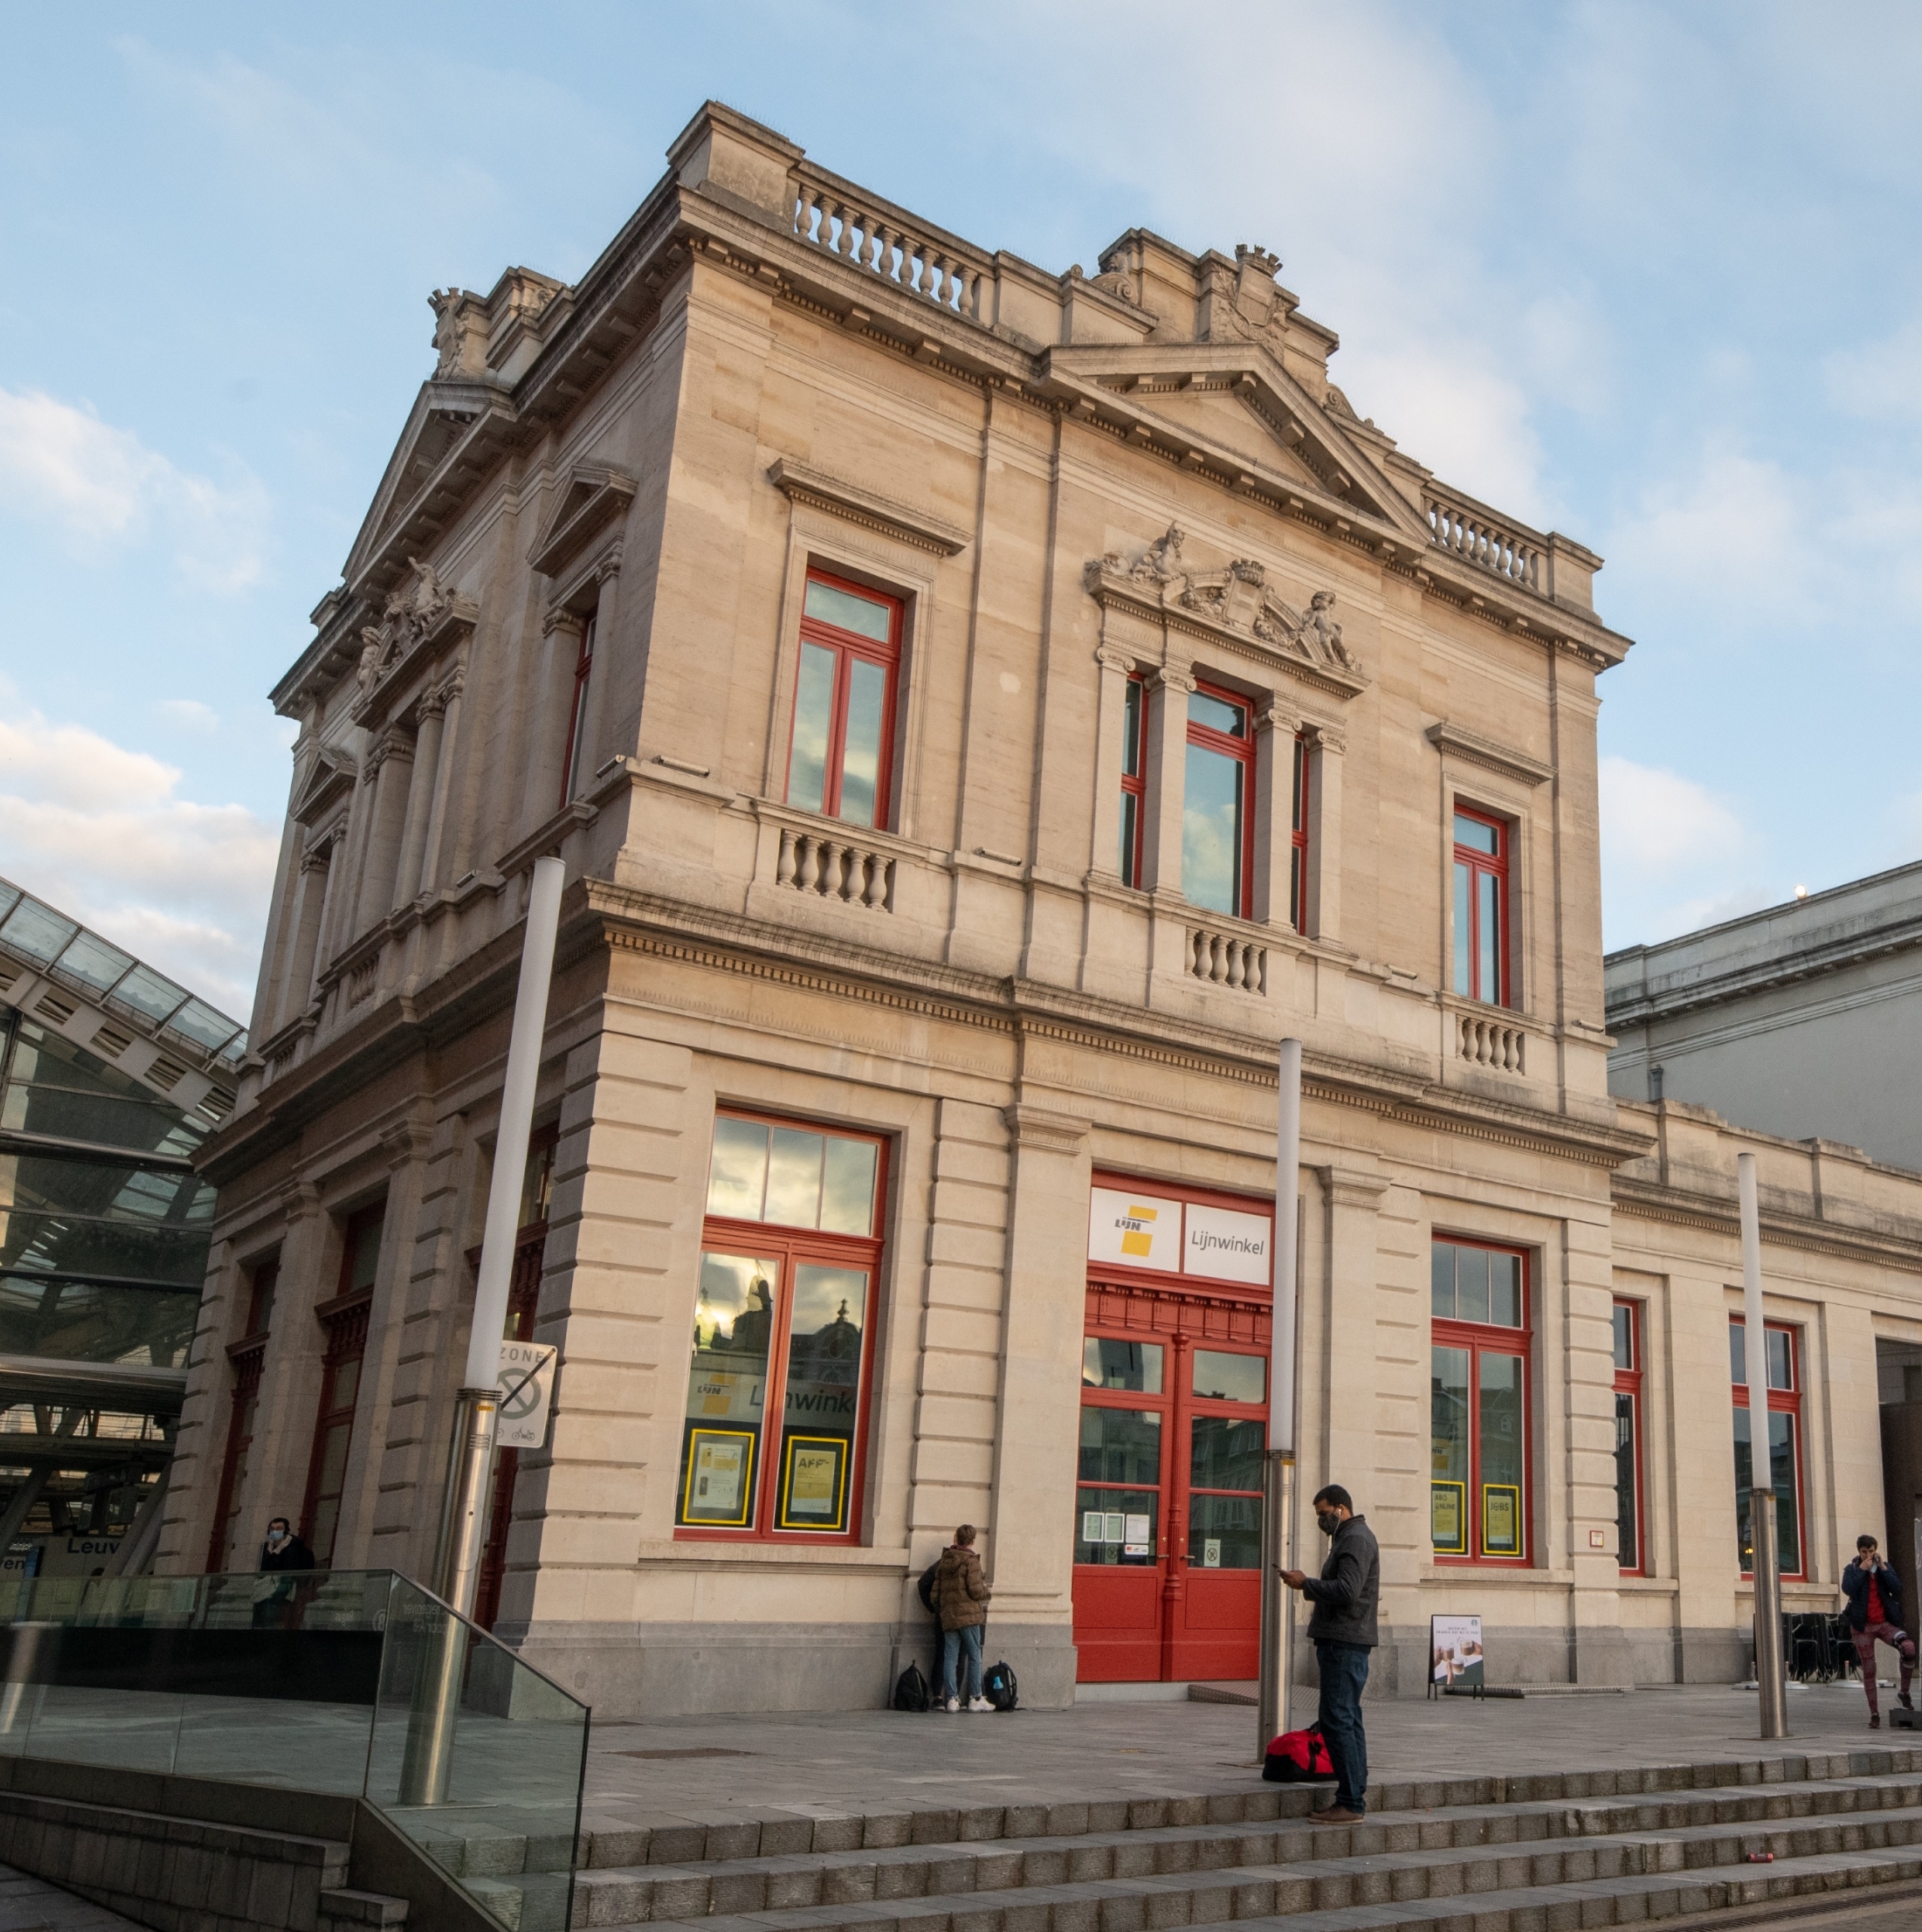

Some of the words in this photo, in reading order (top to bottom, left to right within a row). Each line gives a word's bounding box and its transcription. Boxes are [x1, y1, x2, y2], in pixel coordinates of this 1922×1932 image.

[1192, 1230, 1265, 1255] Lijnwinkel
[500, 1347, 545, 1363] ZONE
[1490, 1501, 1509, 1512] JOBS
[67, 1537, 121, 1555] Leuv
[0, 1558, 25, 1571] en
